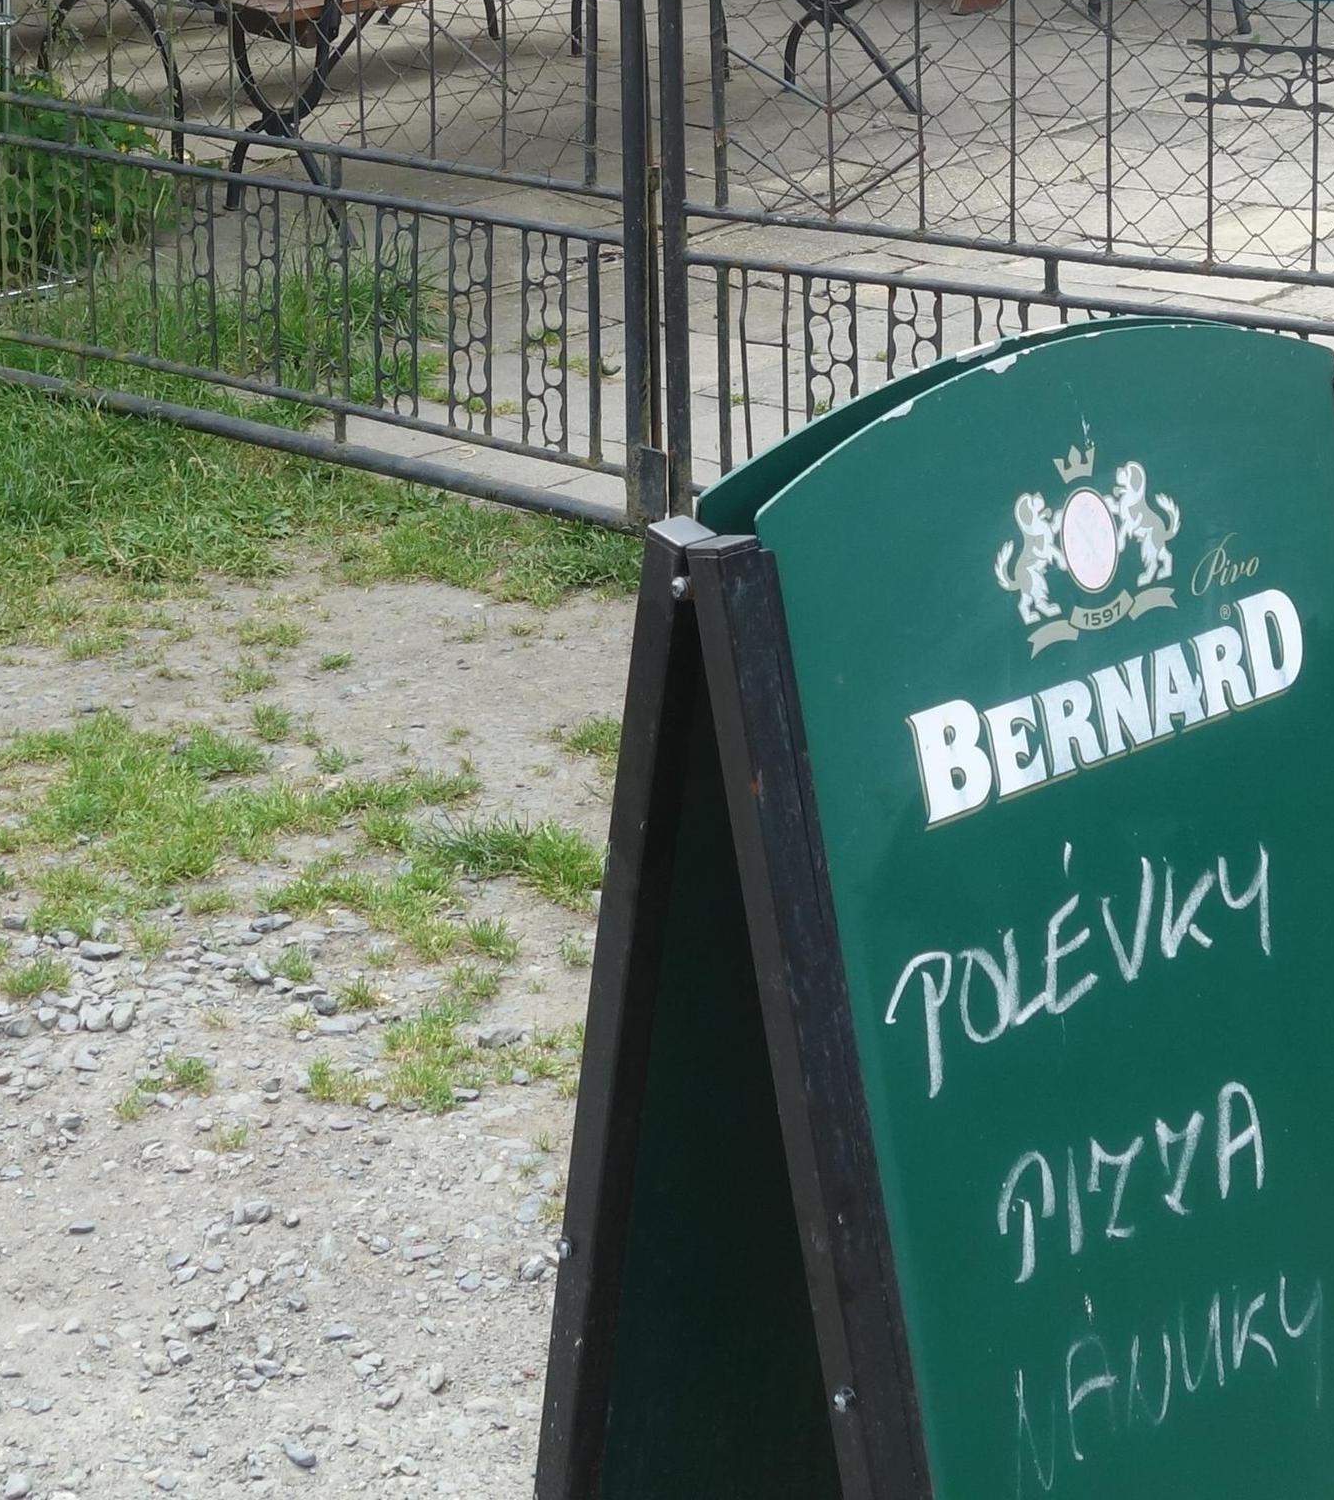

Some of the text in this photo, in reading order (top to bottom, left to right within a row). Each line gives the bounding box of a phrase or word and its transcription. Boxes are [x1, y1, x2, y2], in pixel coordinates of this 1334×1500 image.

[1082, 602, 1123, 627] 1597
[1191, 532, 1260, 595] Pivo
[905, 587, 1304, 830] BERNARD
[885, 841, 1270, 1098] POLÉVKY
[997, 1080, 1266, 1283] PIZZA
